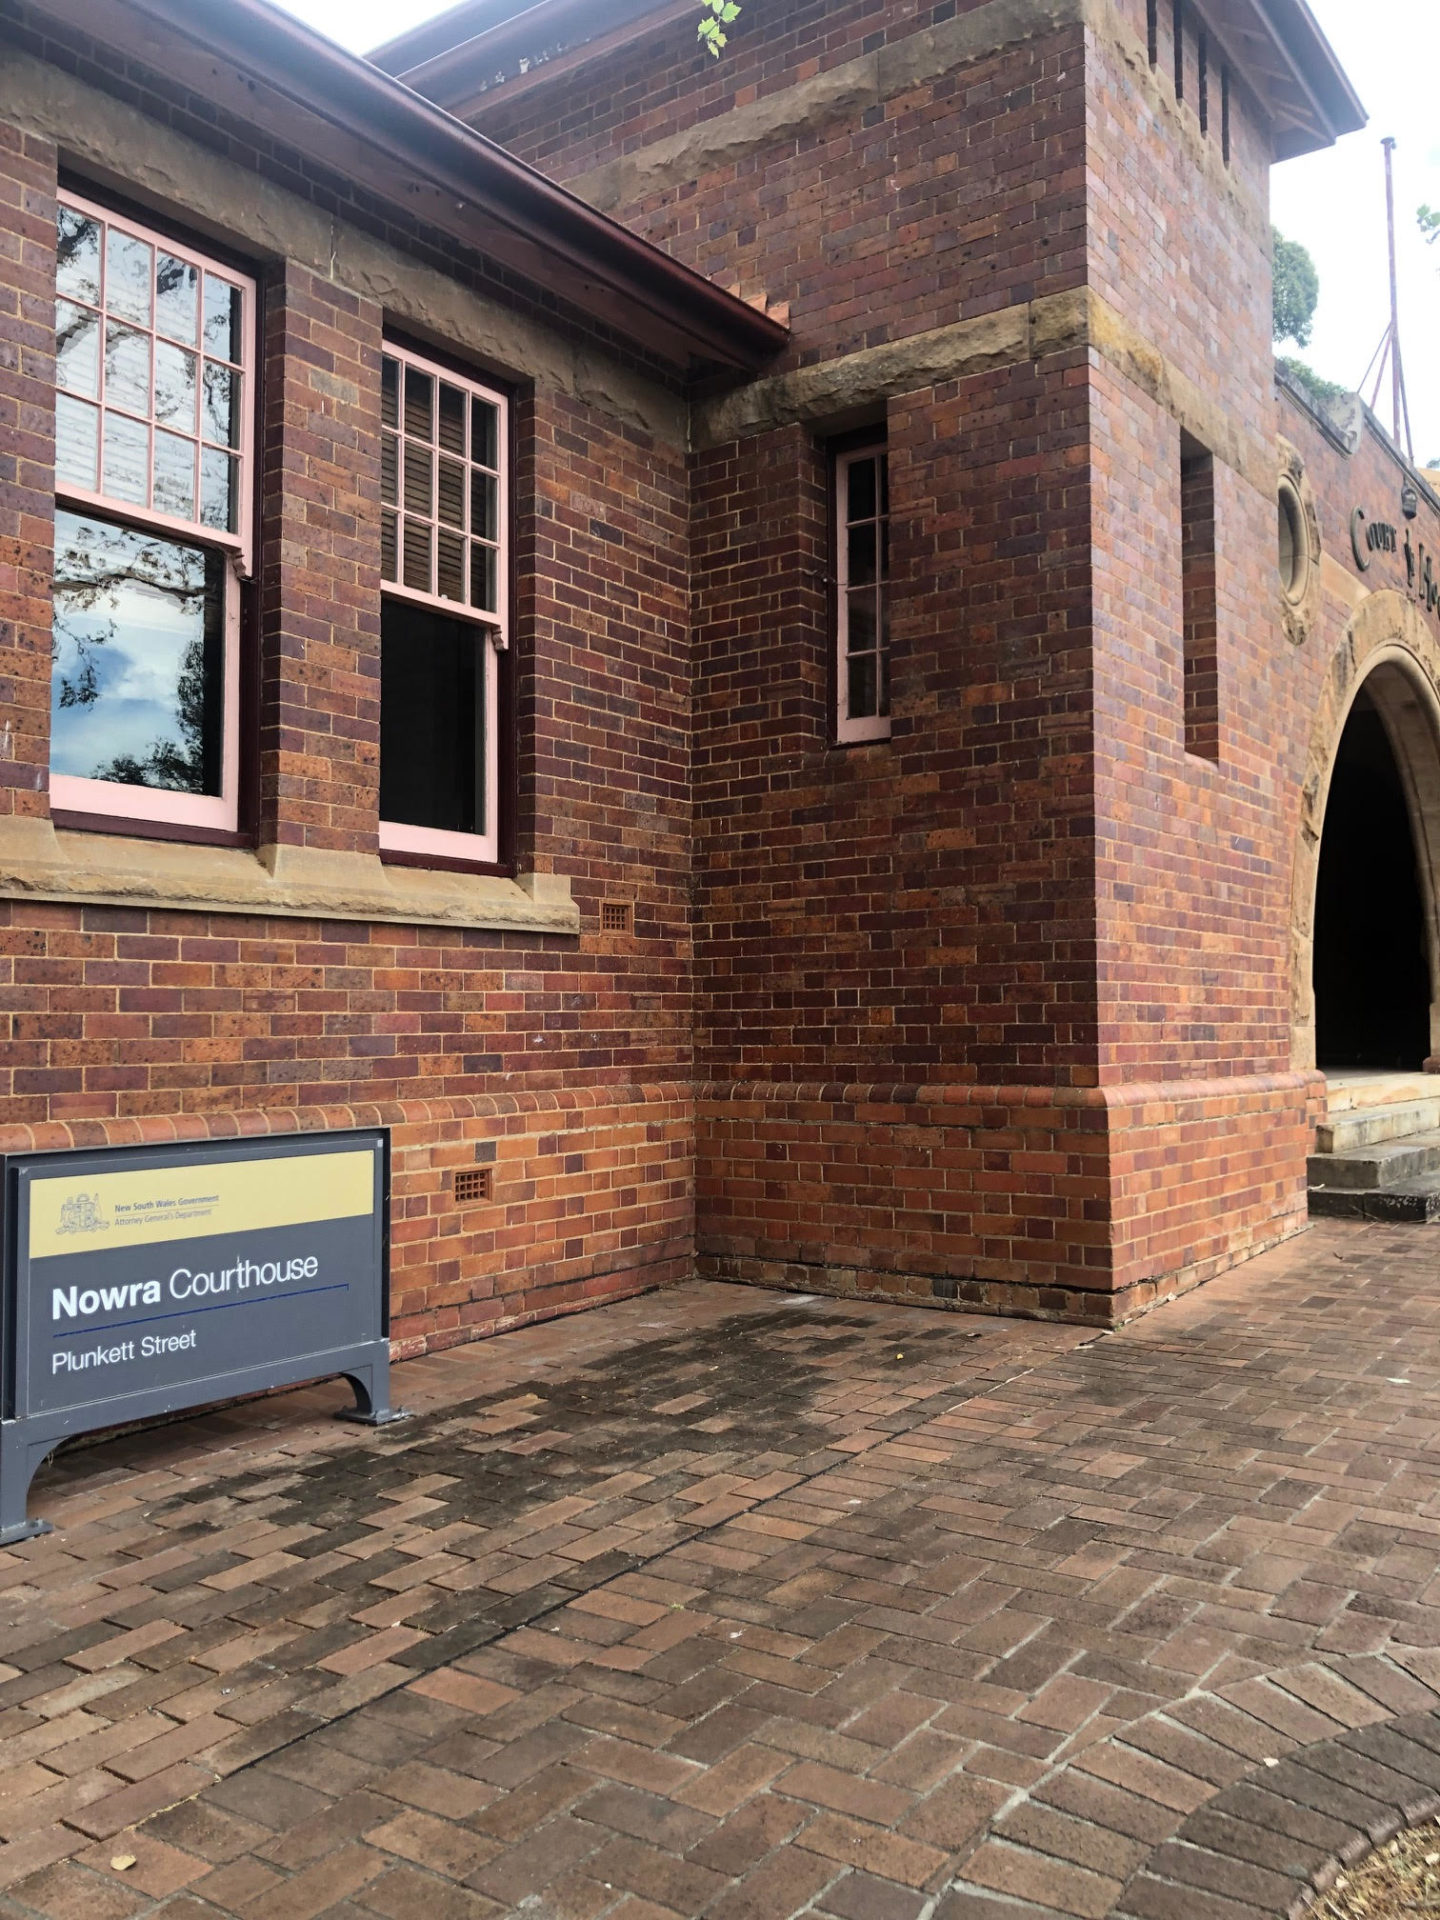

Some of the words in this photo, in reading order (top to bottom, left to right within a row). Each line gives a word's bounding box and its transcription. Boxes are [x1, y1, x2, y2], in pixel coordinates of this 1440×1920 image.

[114, 1204, 131, 1213] New
[133, 1200, 154, 1211] South
[156, 1198, 177, 1208] Wales
[178, 1195, 219, 1206] Government
[114, 1216, 143, 1226] Attorney
[145, 1212, 174, 1223] General's
[176, 1208, 212, 1219] Department
[52, 1279, 161, 1321] Nowra
[169, 1255, 319, 1300] Courthouse
[52, 1339, 135, 1375] Plunkett
[141, 1329, 197, 1357] Street
